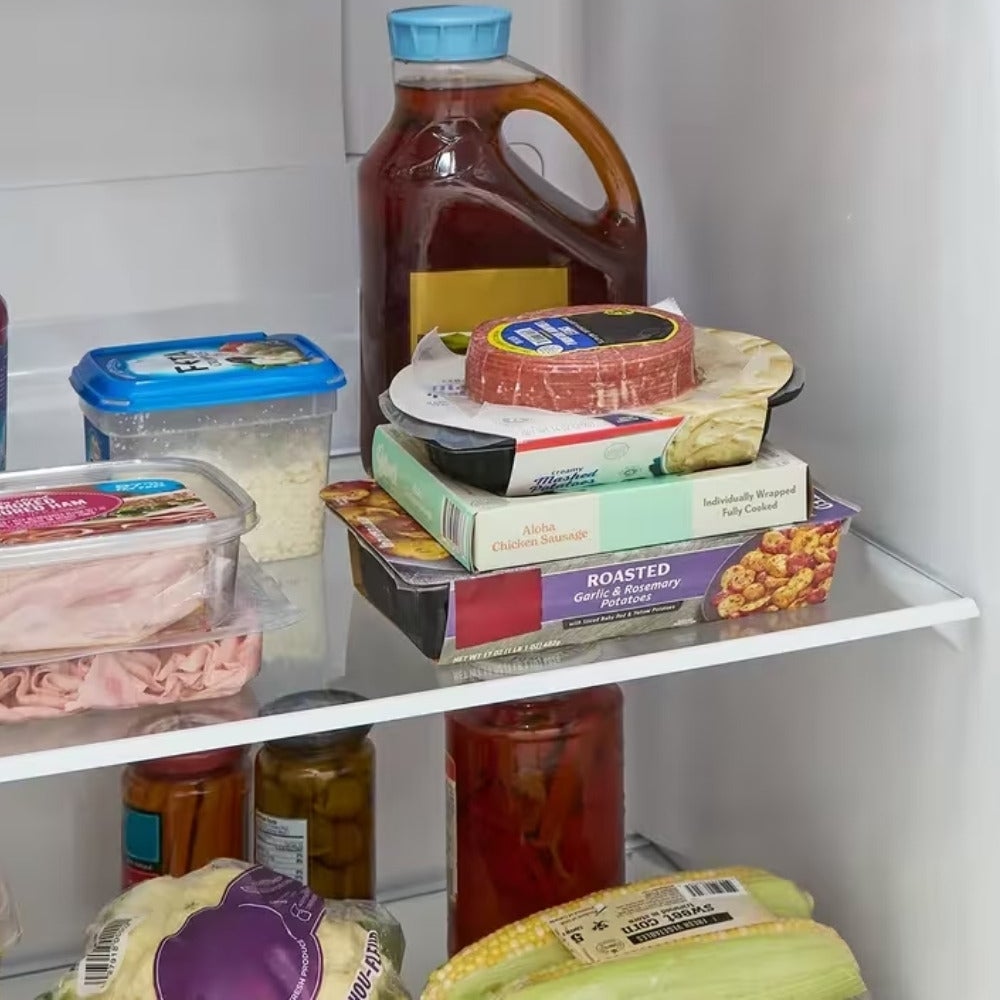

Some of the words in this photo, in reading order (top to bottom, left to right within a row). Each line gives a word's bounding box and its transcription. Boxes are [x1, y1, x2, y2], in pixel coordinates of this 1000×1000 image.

[534, 468, 599, 485] Mashed
[551, 466, 584, 476] creamy
[702, 492, 754, 509] Individually
[755, 485, 797, 503] Wrapped
[721, 505, 743, 518] Fully
[745, 500, 778, 515] Cooked
[522, 522, 556, 536] Aloha
[491, 537, 538, 553] Chicken
[540, 528, 589, 546] Sausage
[587, 563, 671, 588] ROASTED
[574, 587, 610, 603] Garlic
[612, 585, 621, 597] &
[624, 577, 682, 595] Rosemary
[600, 593, 653, 609] Potatoes
[615, 611, 626, 619] Red
[652, 605, 675, 613] Potatoes
[453, 656, 467, 664] NET
[469, 653, 482, 661] WT
[662, 902, 715, 923] sweet
[621, 917, 660, 935] corn
[570, 933, 585, 944] 5
